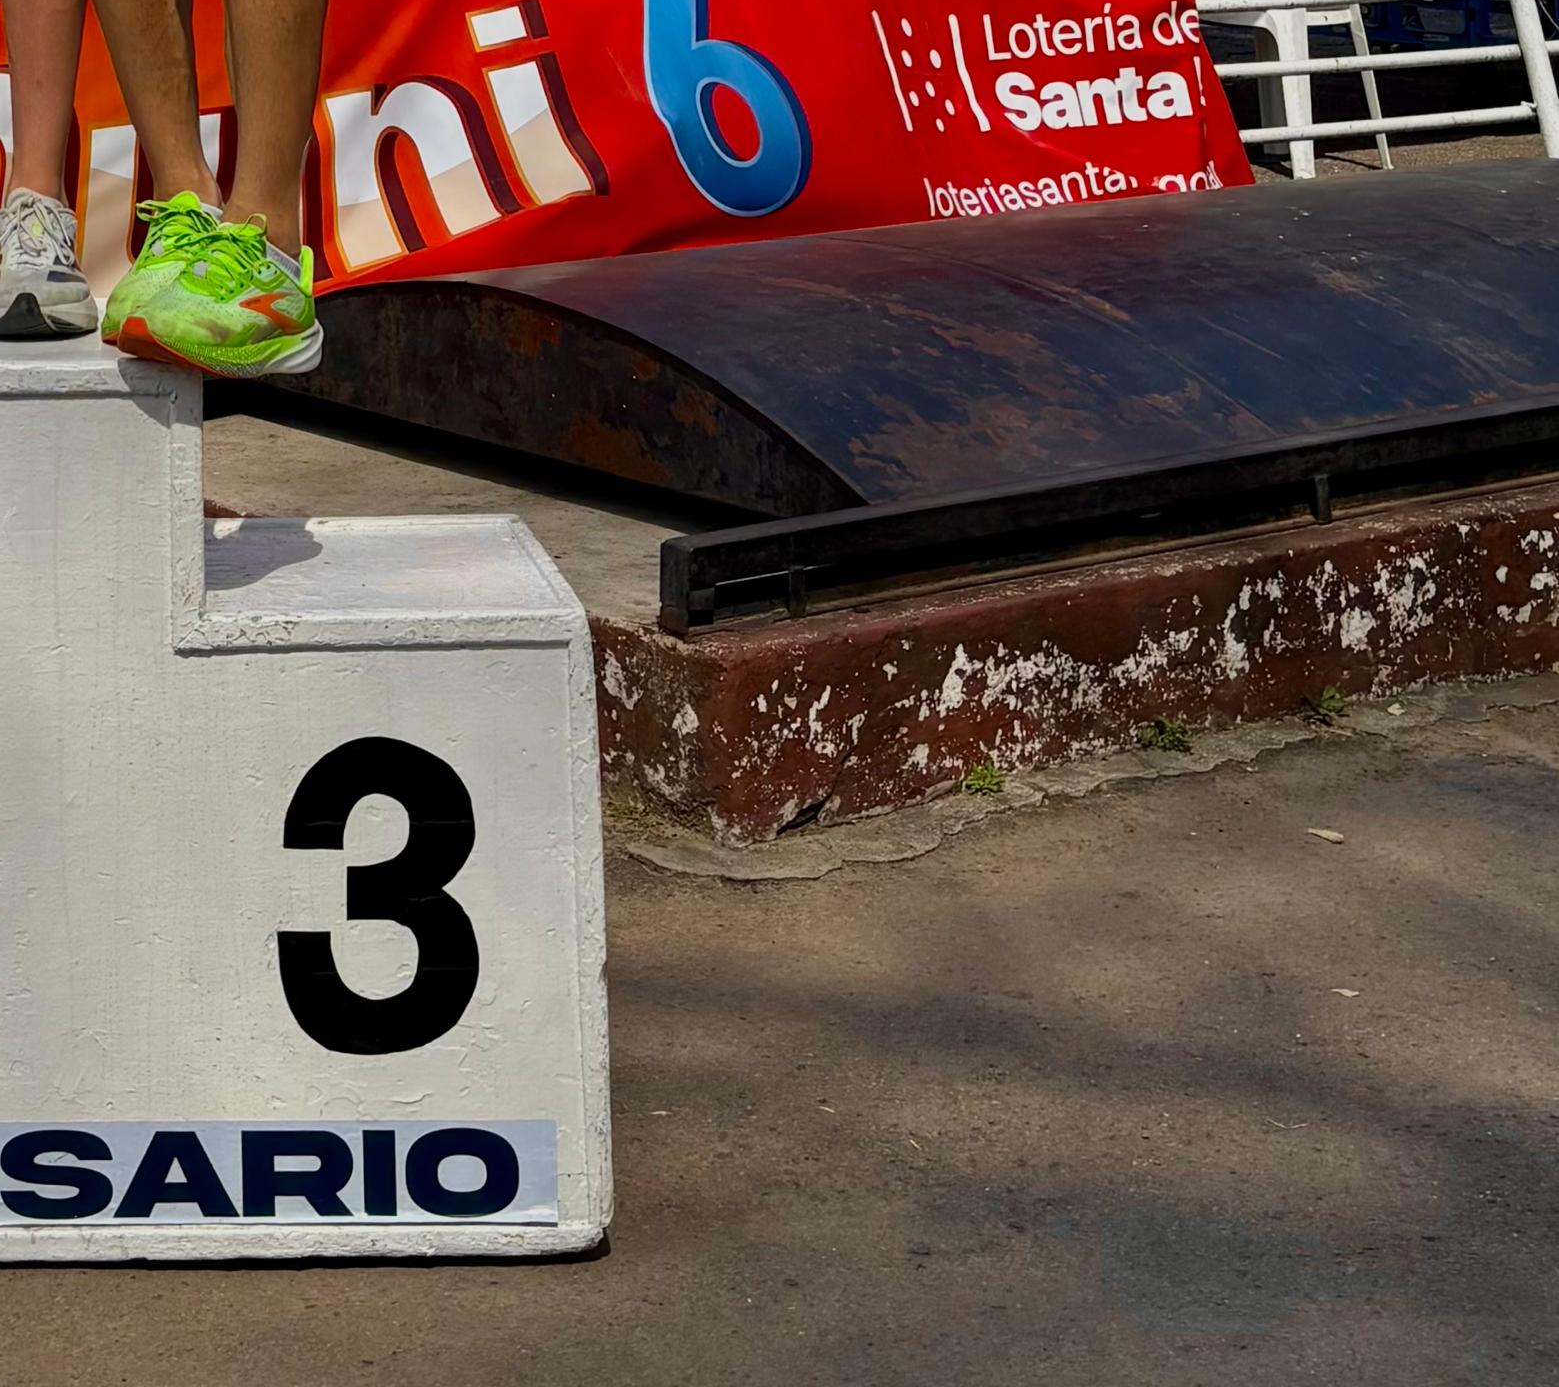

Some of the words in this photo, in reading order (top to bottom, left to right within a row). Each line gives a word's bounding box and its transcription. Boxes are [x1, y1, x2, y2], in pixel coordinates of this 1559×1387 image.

[983, 3, 1143, 61] Lotería
[1152, 1, 1200, 47] de
[995, 67, 1194, 131] Santa
[277, 737, 479, 1055] 3
